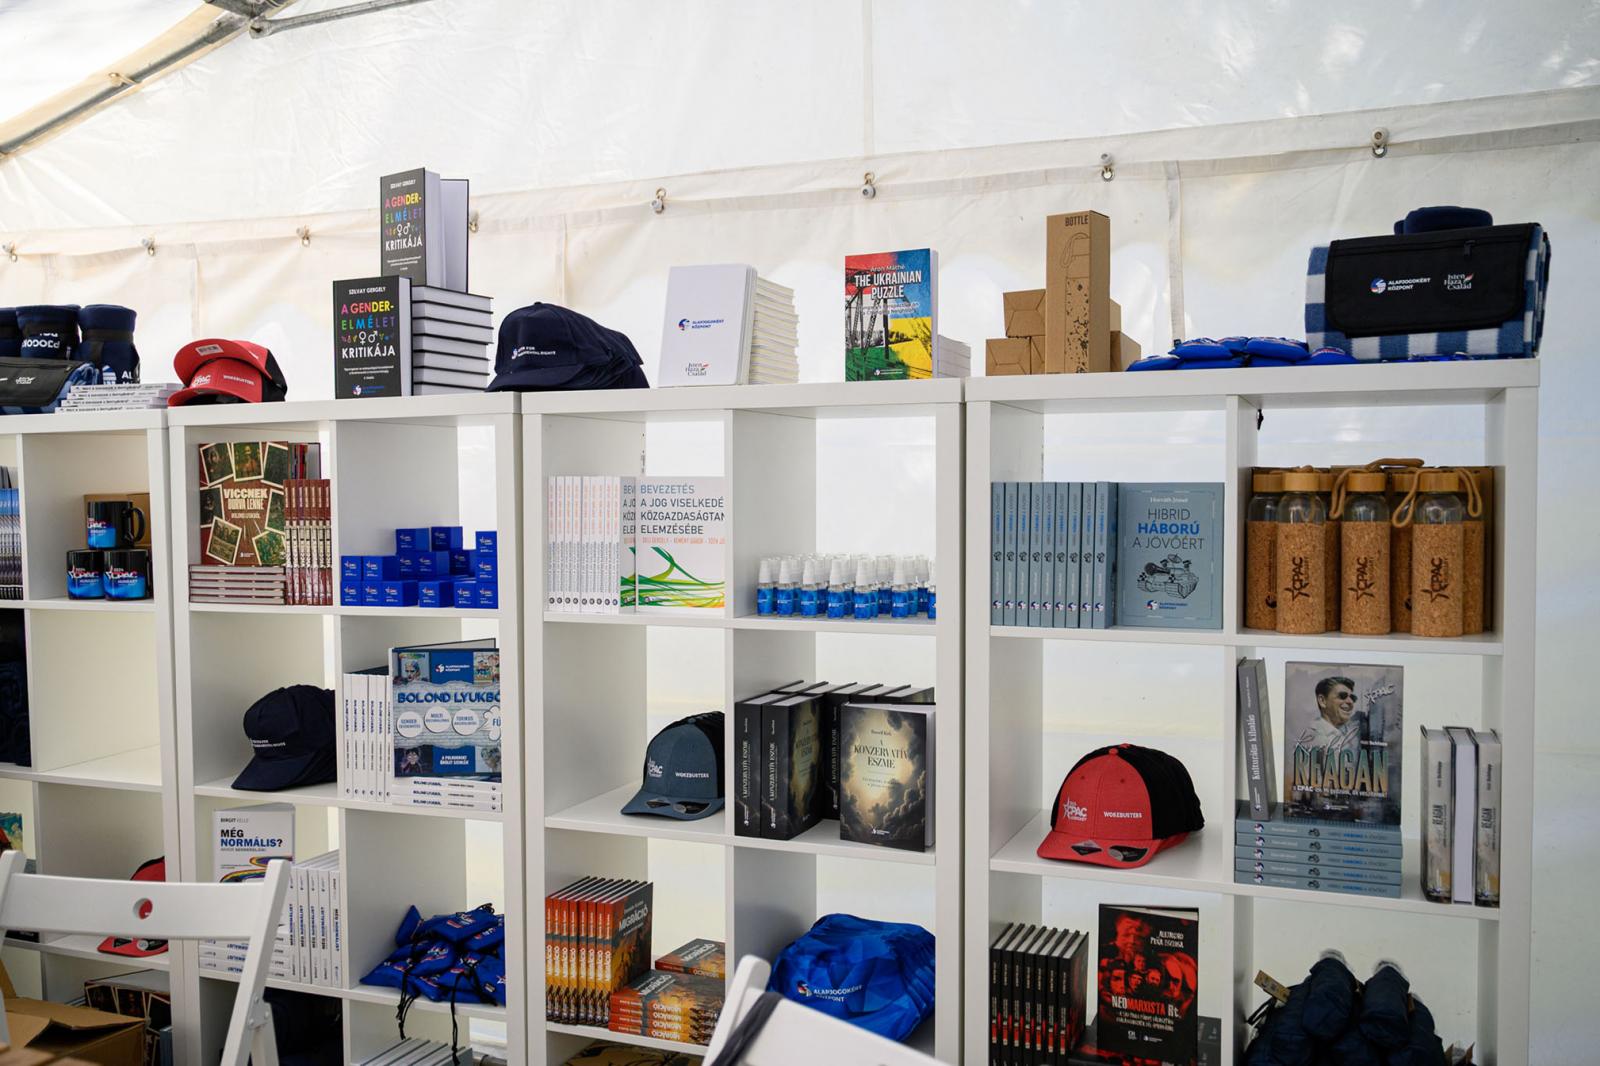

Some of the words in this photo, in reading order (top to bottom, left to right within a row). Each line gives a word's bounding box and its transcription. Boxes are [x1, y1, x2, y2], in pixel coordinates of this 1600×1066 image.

[1065, 215, 1088, 226] BOTTLE
[854, 274, 870, 287] THE
[873, 270, 922, 286] UKRAINIAN
[871, 285, 904, 299] PUZZLE
[341, 303, 348, 314] A
[350, 301, 394, 314] GENDER-
[341, 315, 395, 330] ELMÉLET
[342, 343, 395, 359] KRITIKÁJA
[224, 488, 268, 499] VICCNEK
[640, 483, 695, 494] BEVEZETÉS
[640, 499, 647, 507] A
[650, 499, 668, 507] JOG
[670, 496, 724, 507] VISELKEDÉ
[1147, 508, 1190, 520] HIBRID
[641, 524, 704, 534] ELEMZÉSÉBE
[1137, 520, 1200, 535] HÁBORÚ
[1132, 537, 1141, 548] A
[1146, 535, 1204, 550] JÖVŐÉRT
[1292, 556, 1303, 591] CPAC
[1357, 556, 1367, 591] CPAC
[1430, 556, 1442, 593] CPAC
[397, 692, 451, 704] BOLOND
[867, 756, 895, 769] ESZME
[1294, 746, 1389, 794] REAGAN
[1103, 810, 1143, 818] WOKEBUSTERS
[220, 827, 244, 838] MÉG
[220, 836, 283, 847] NORMÁLIS?
[1111, 995, 1165, 1015] NEOMARXISTA
